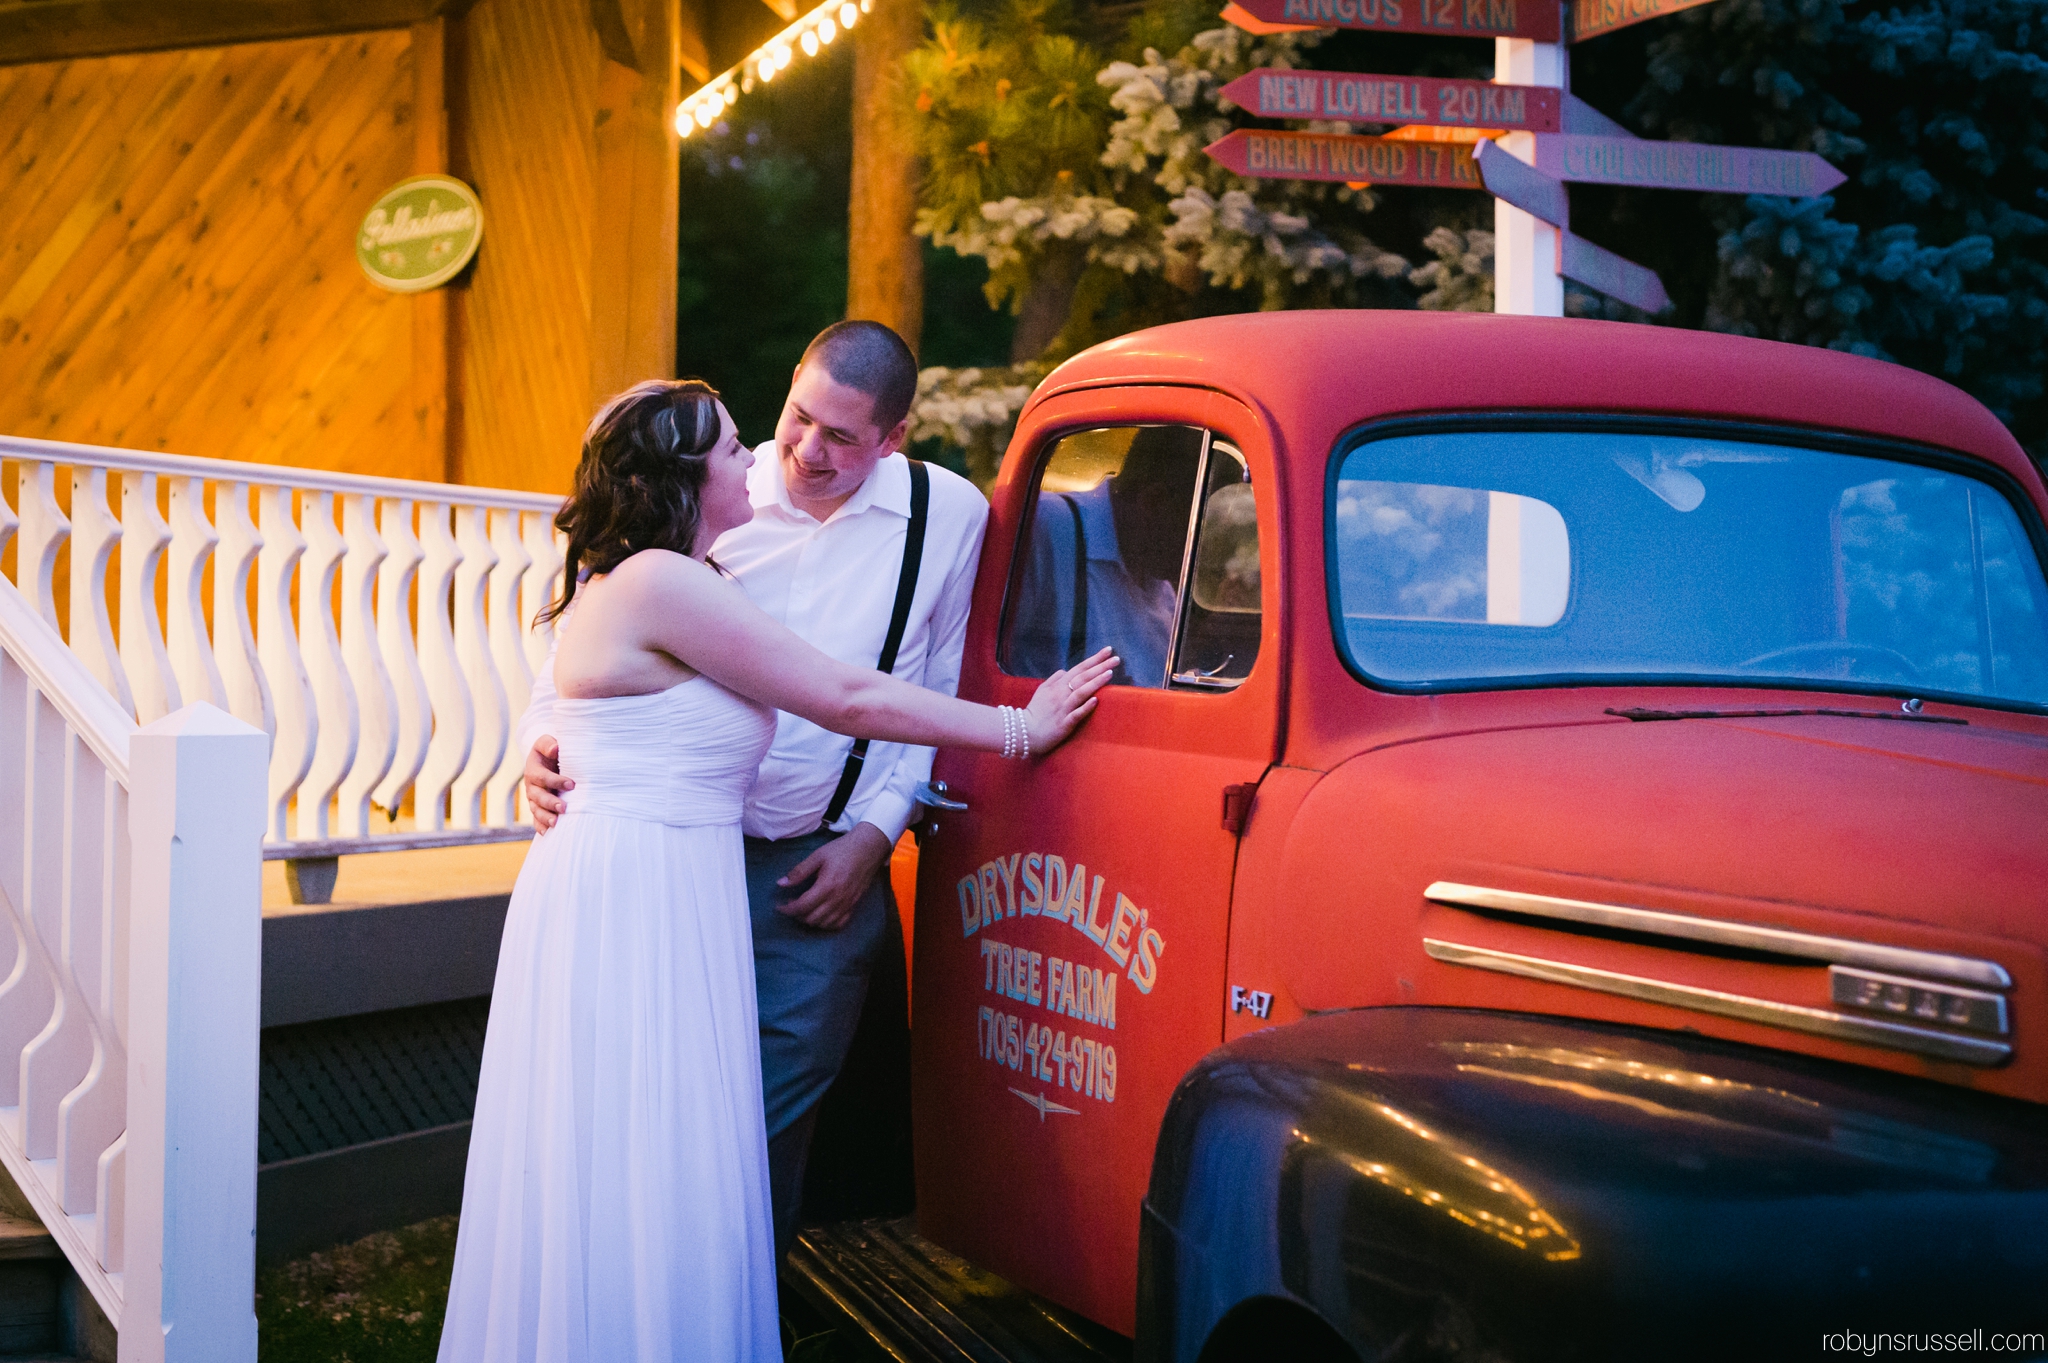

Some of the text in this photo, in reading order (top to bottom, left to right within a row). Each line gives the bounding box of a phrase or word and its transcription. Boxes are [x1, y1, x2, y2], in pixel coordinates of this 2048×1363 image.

[1259, 76, 1317, 113] NEW
[1322, 79, 1427, 120] LOWELL
[1247, 136, 1408, 180] BRENTWOOD
[1416, 145, 1444, 181] 17
[957, 852, 1167, 995] DRYSDALE'S
[980, 938, 1118, 1030] TREE FARM
